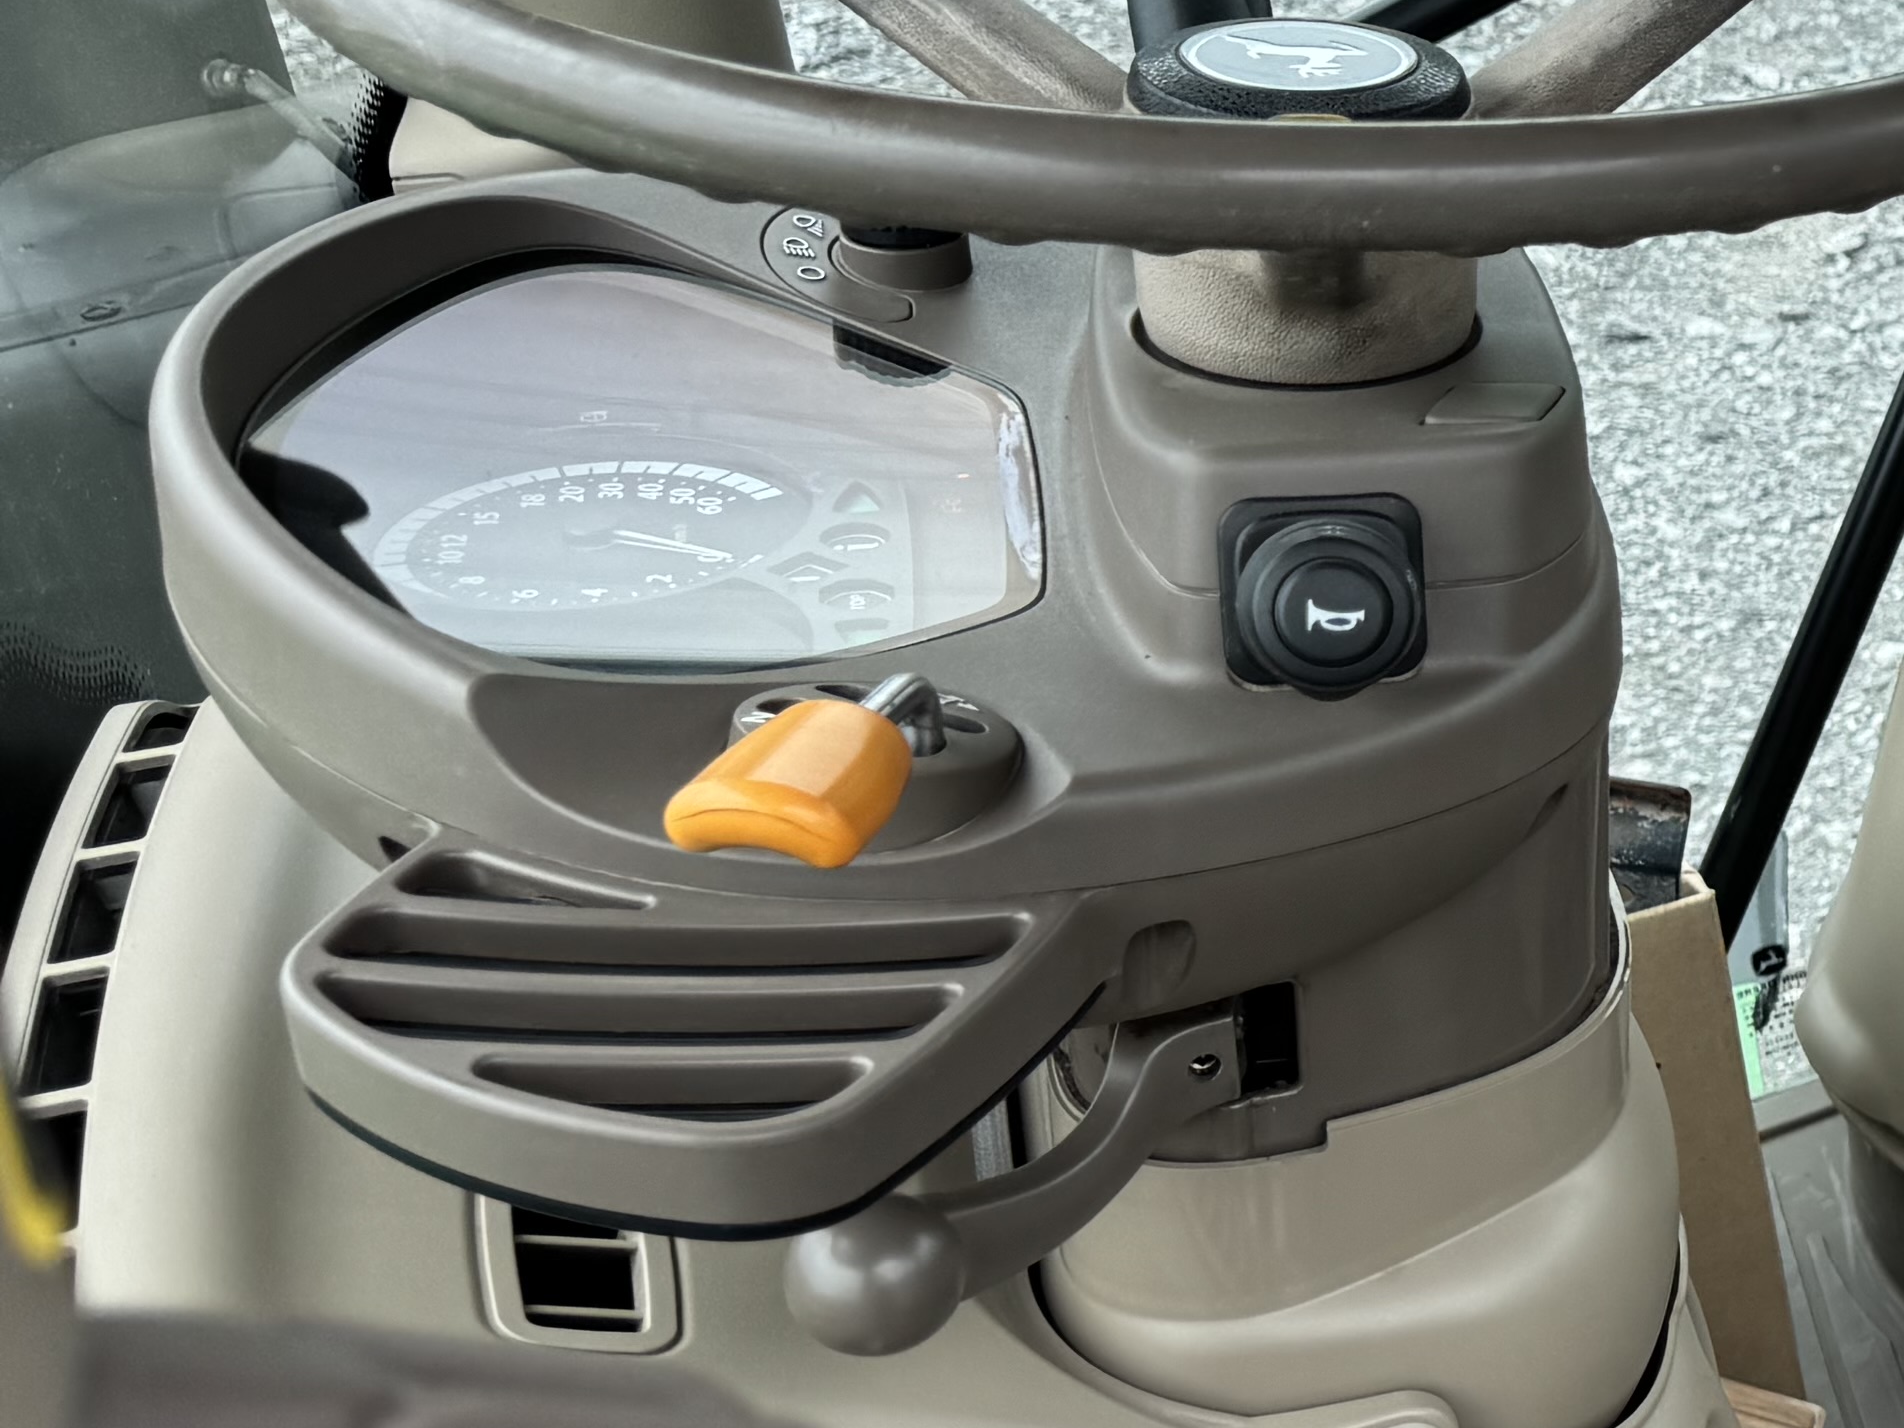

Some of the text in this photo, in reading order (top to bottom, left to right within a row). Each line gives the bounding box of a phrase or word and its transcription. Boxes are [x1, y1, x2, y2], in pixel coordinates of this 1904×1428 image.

[559, 486, 584, 503] 20
[598, 482, 624, 500] 30
[638, 483, 663, 500] 40
[671, 488, 695, 505] 50
[521, 494, 545, 507] 18
[697, 497, 722, 515] 60
[474, 512, 499, 525] 15
[442, 534, 467, 547] 12
[439, 550, 464, 565] 10
[458, 576, 485, 585] 8
[647, 574, 672, 584] 2
[515, 590, 539, 599] 6
[581, 588, 607, 599] 4
